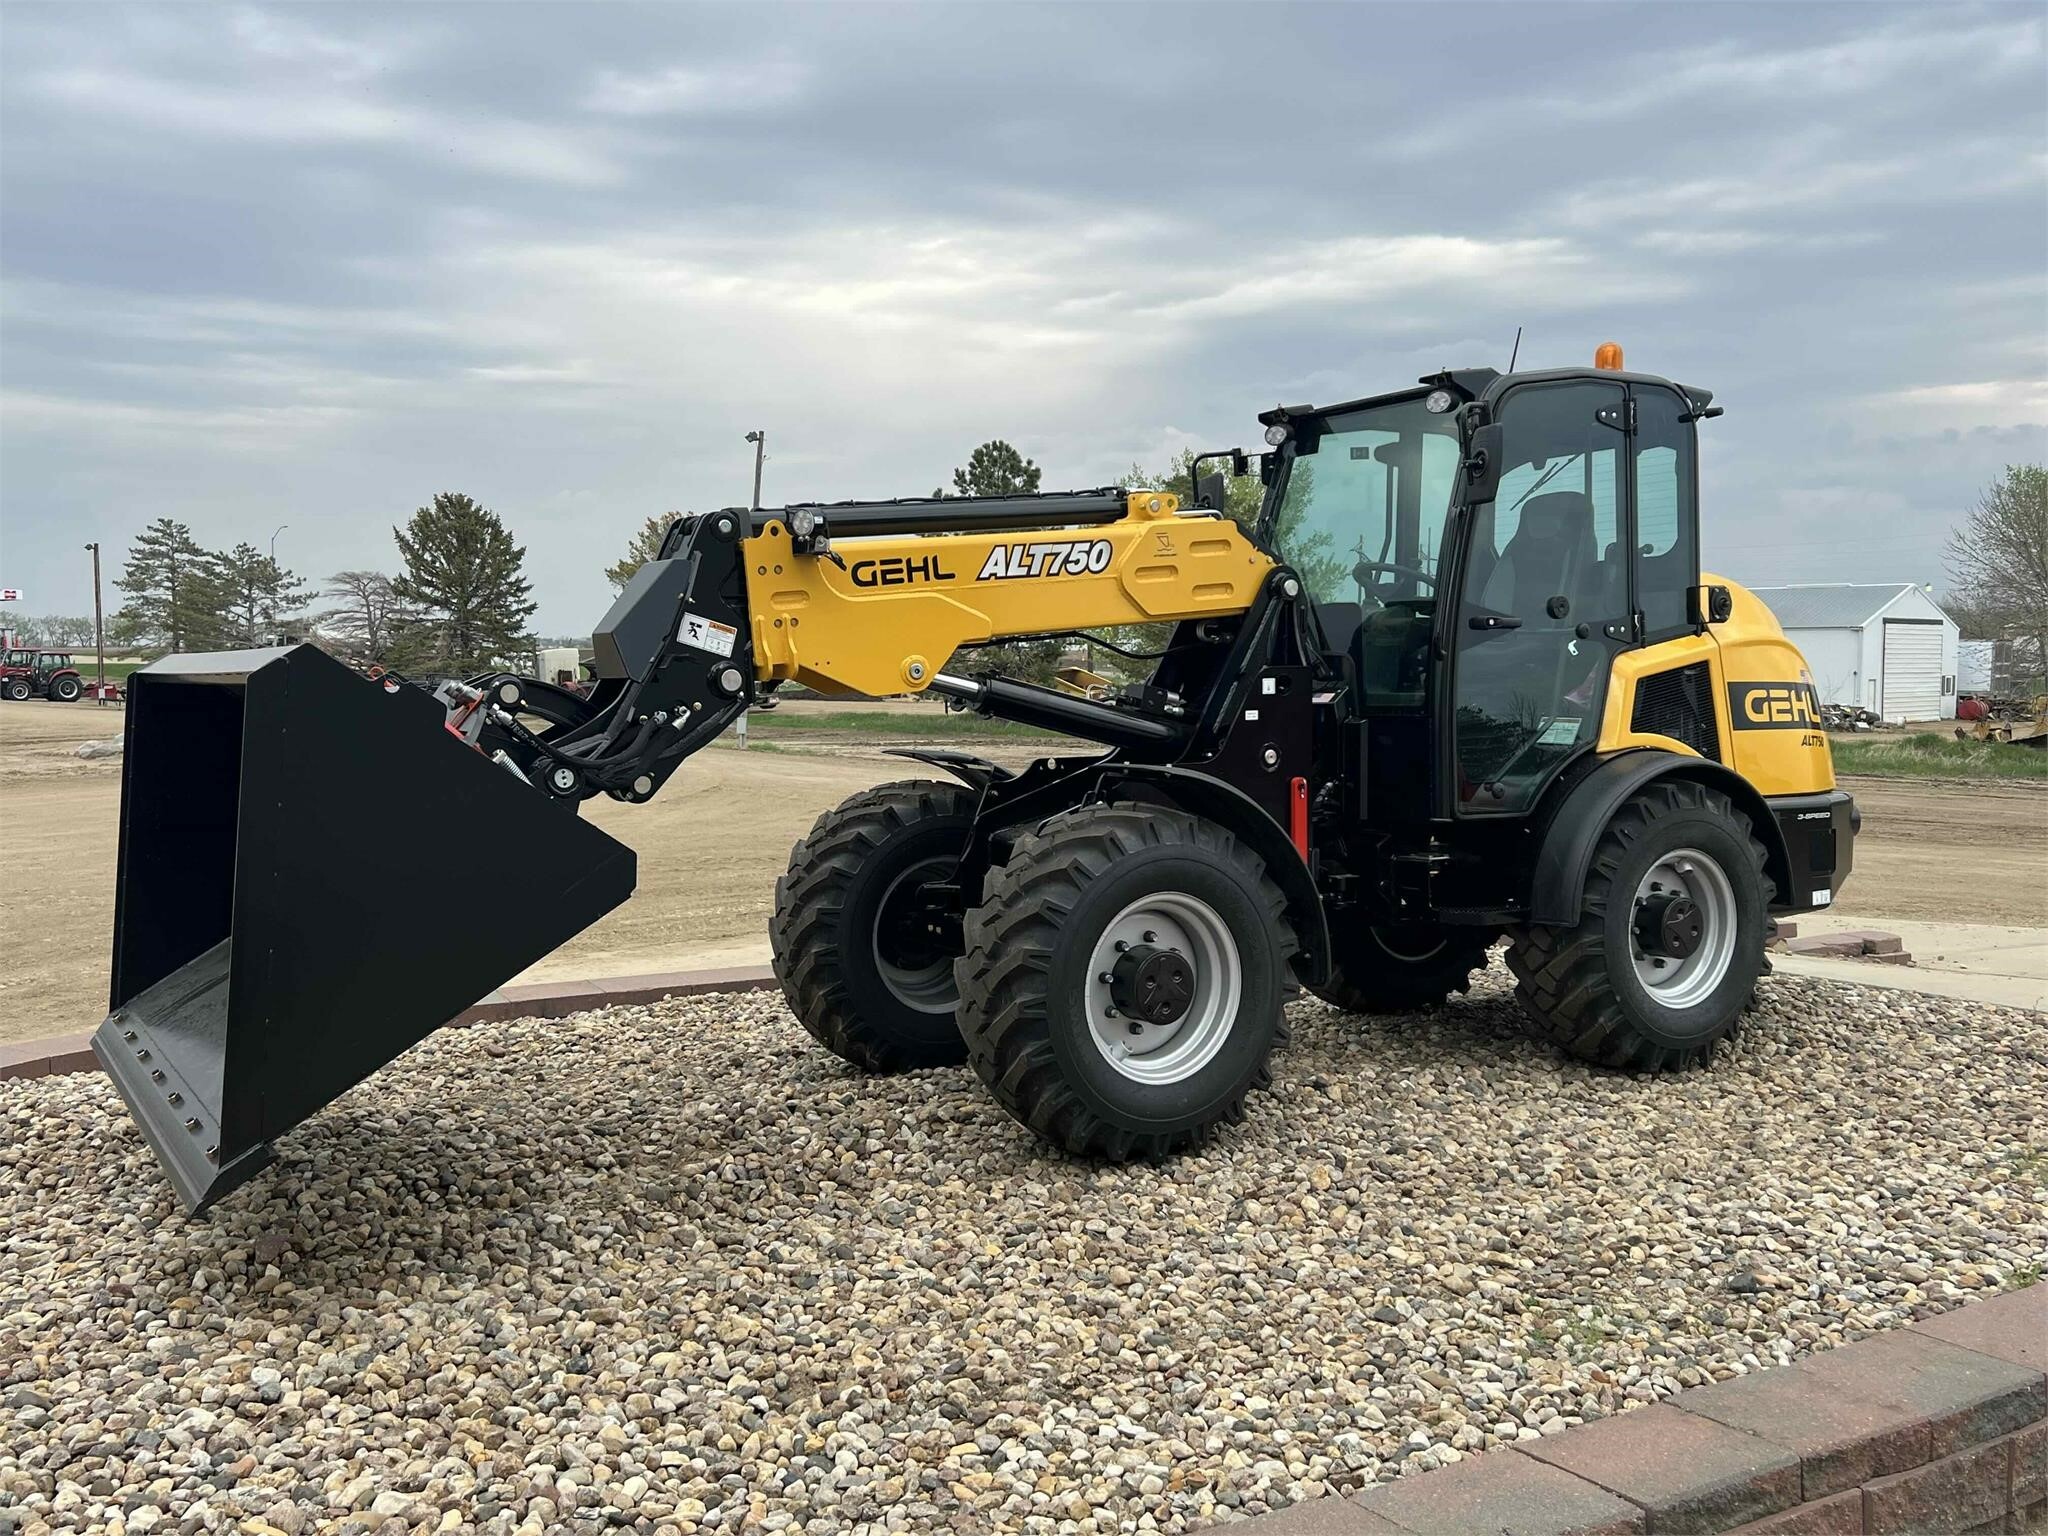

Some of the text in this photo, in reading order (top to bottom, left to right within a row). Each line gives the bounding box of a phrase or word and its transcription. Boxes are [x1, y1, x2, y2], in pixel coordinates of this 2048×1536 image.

[851, 539, 1113, 587] GEHL ALT750
[1744, 689, 1820, 723] GEHL
